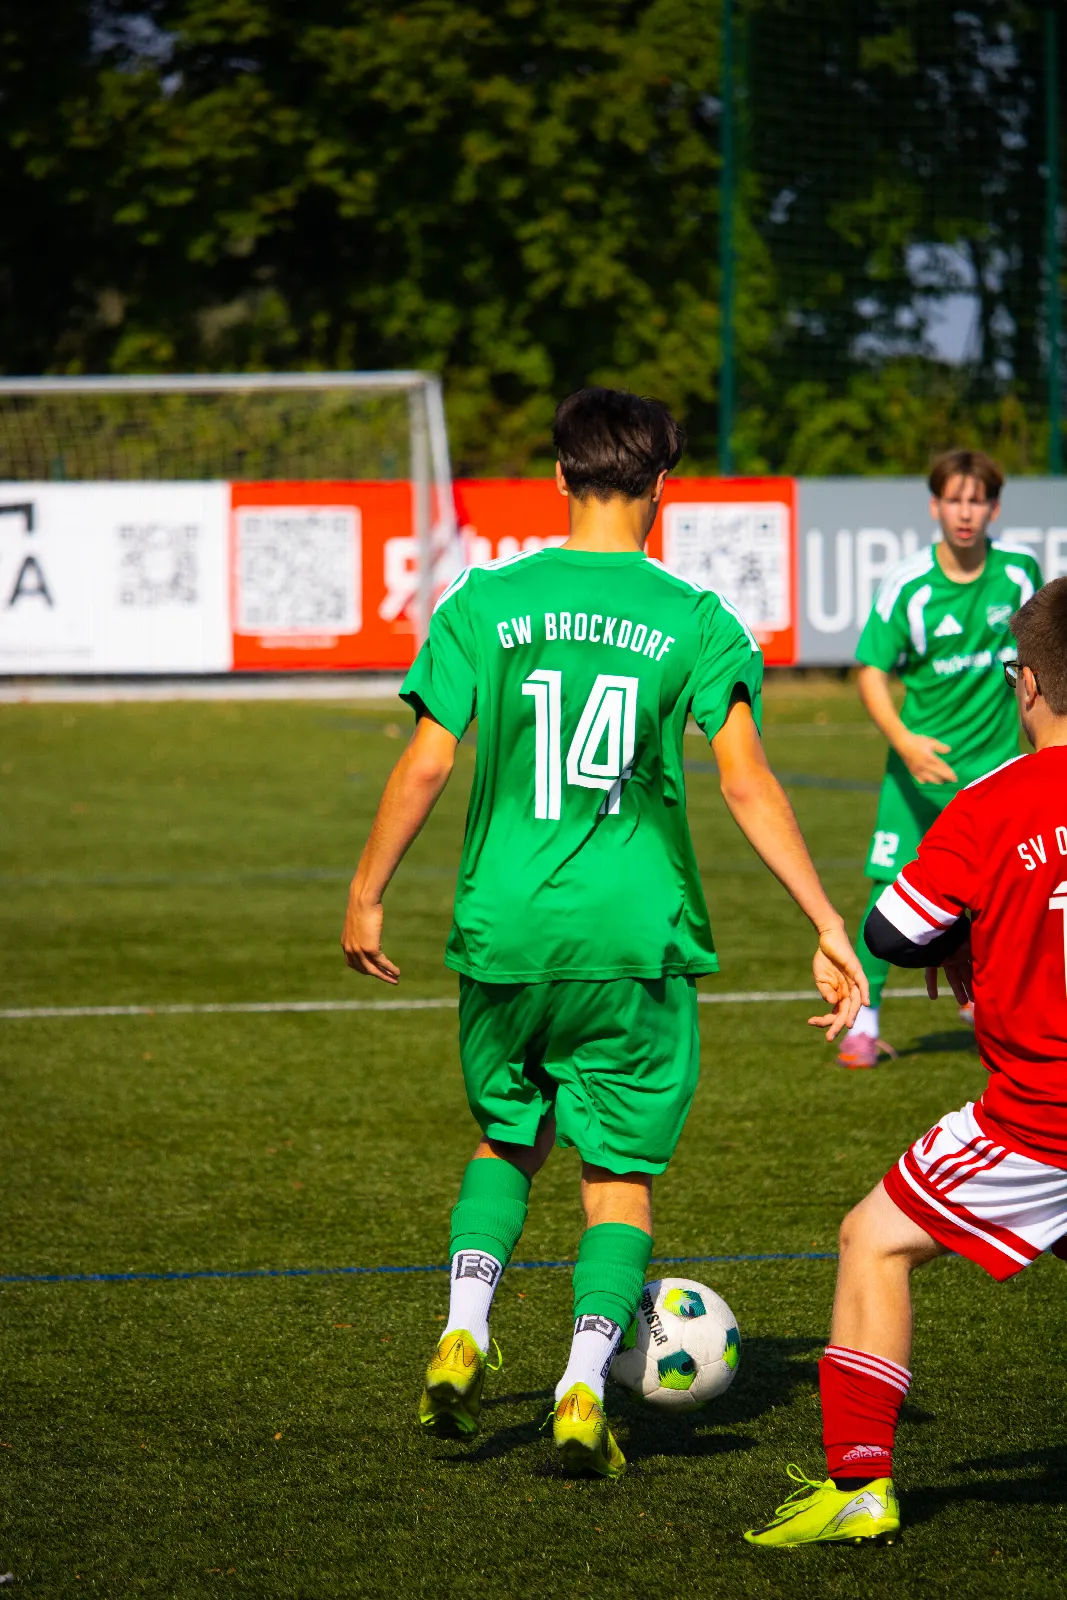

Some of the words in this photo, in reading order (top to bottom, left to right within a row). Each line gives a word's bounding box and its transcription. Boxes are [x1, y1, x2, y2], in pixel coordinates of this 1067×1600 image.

[497, 615, 532, 649] GW
[544, 611, 676, 662] BROCKDORF
[522, 668, 639, 820] 14
[870, 830, 900, 869] 12
[1017, 834, 1047, 871] SV
[460, 1255, 496, 1283] FS
[842, 1449, 890, 1461] adidas
